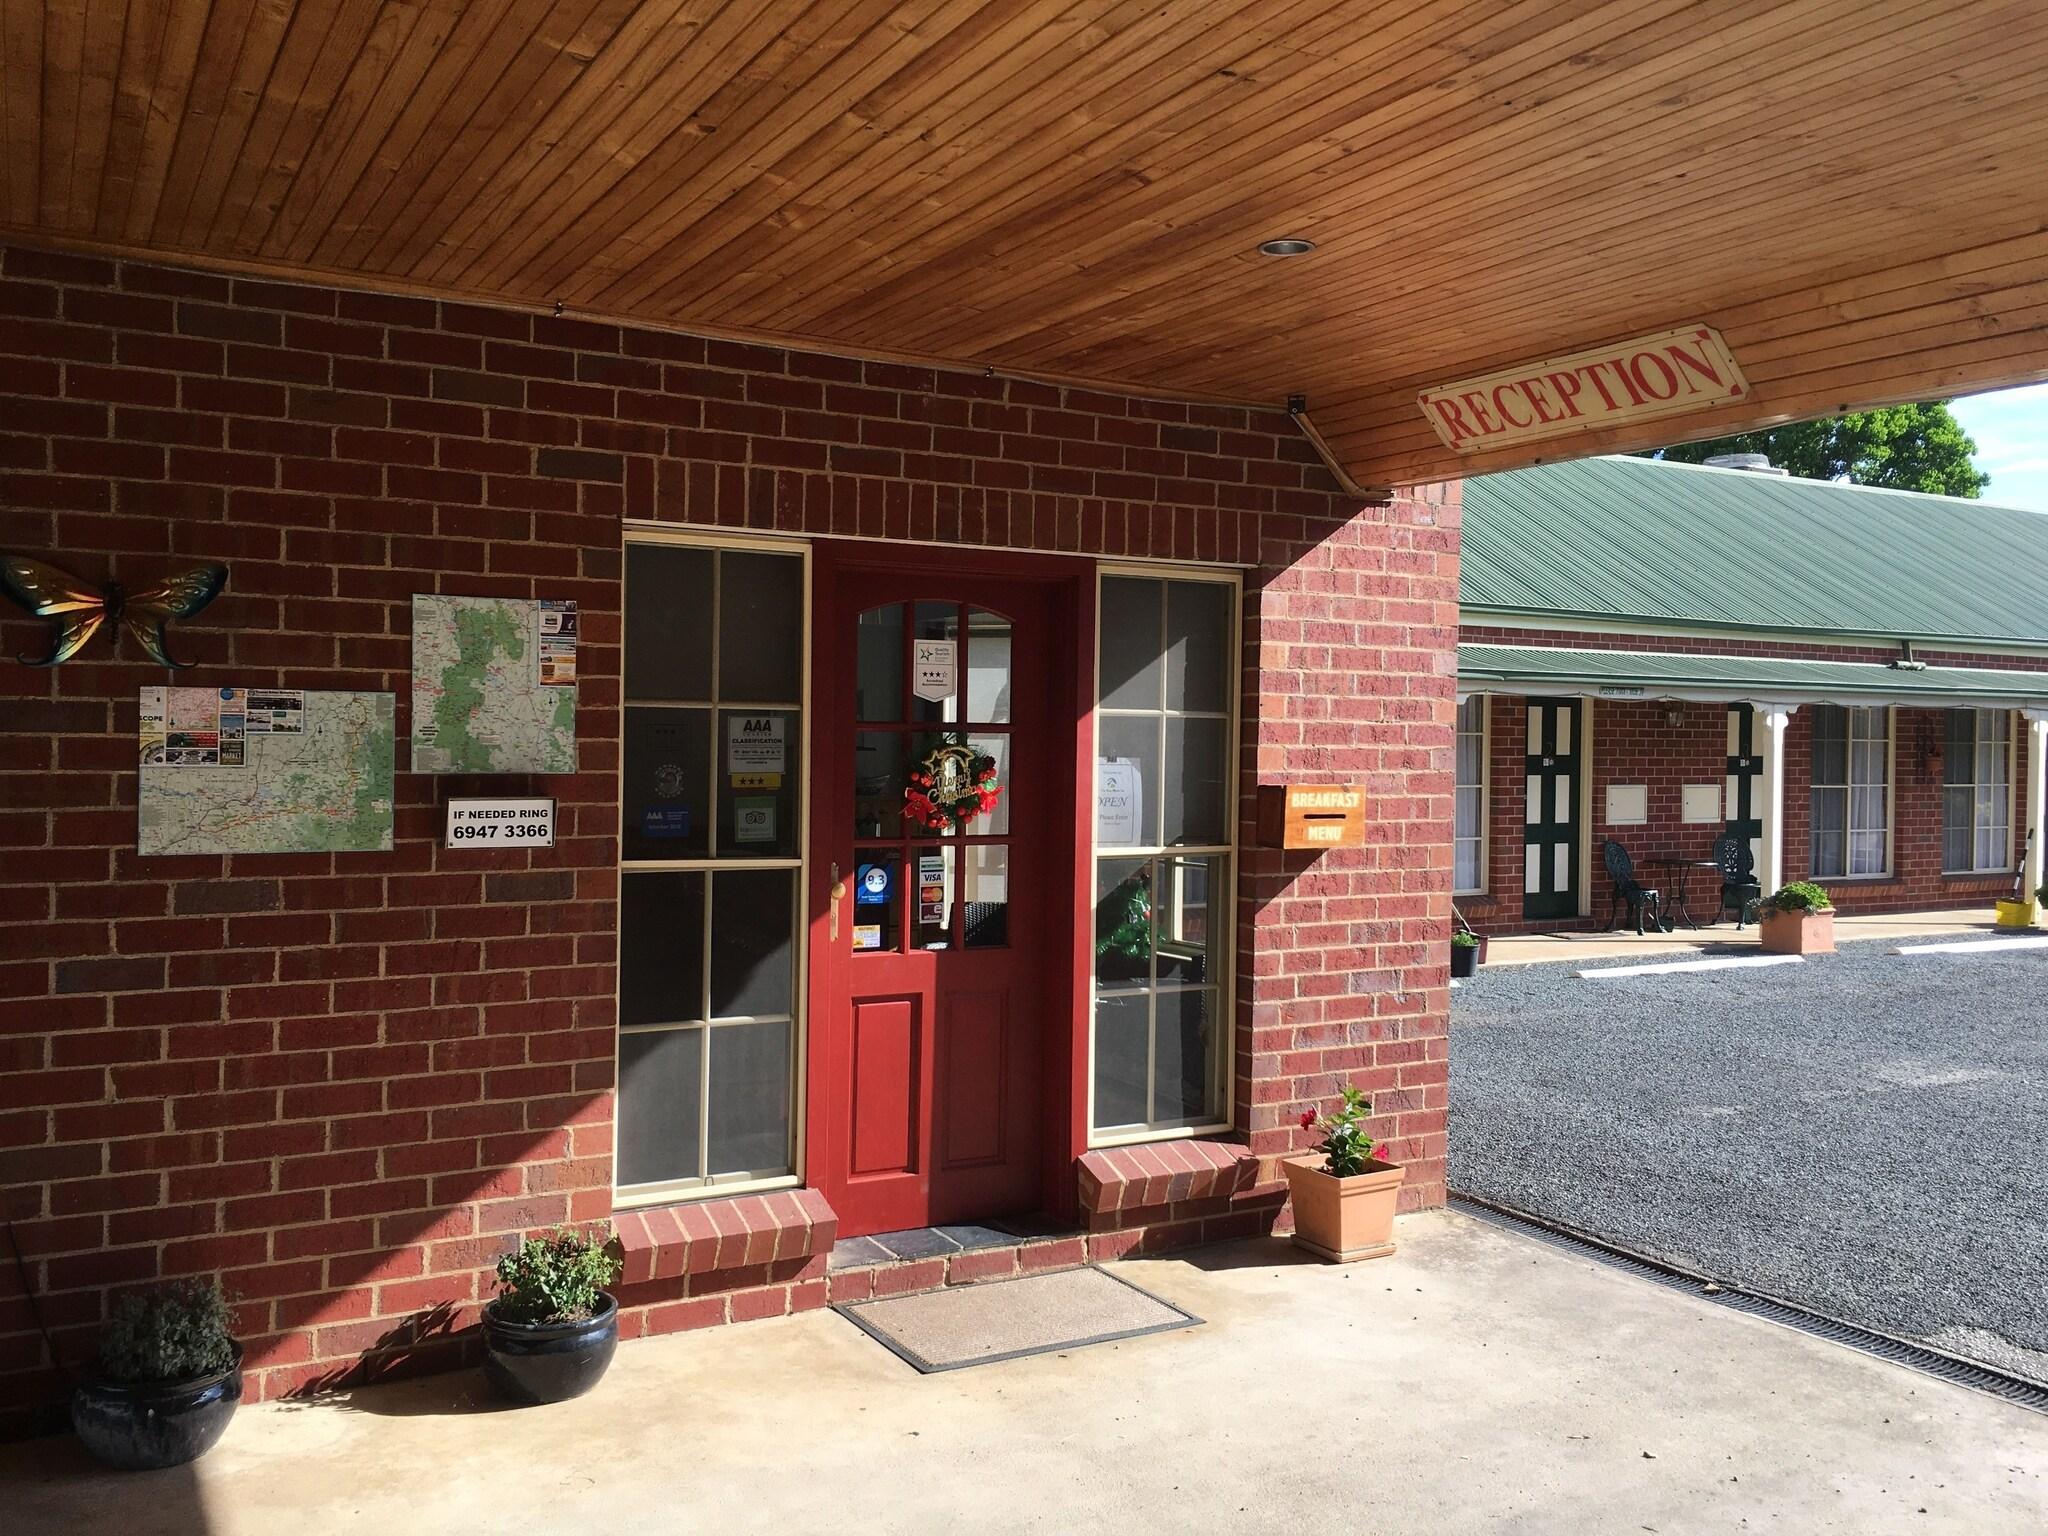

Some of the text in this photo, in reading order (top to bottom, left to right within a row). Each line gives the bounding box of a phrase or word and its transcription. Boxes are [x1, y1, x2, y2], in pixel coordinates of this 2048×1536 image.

[1431, 337, 1725, 442] RECEPTION
[743, 720, 772, 731] AAA
[927, 785, 978, 805] Christma
[1291, 792, 1360, 808] BREAKFAST
[454, 810, 548, 819] IF NEEDED RING
[454, 824, 548, 839] 6947 3366
[1307, 826, 1344, 841] MENU
[867, 874, 885, 886] 9.3
[923, 874, 941, 882] VISA
